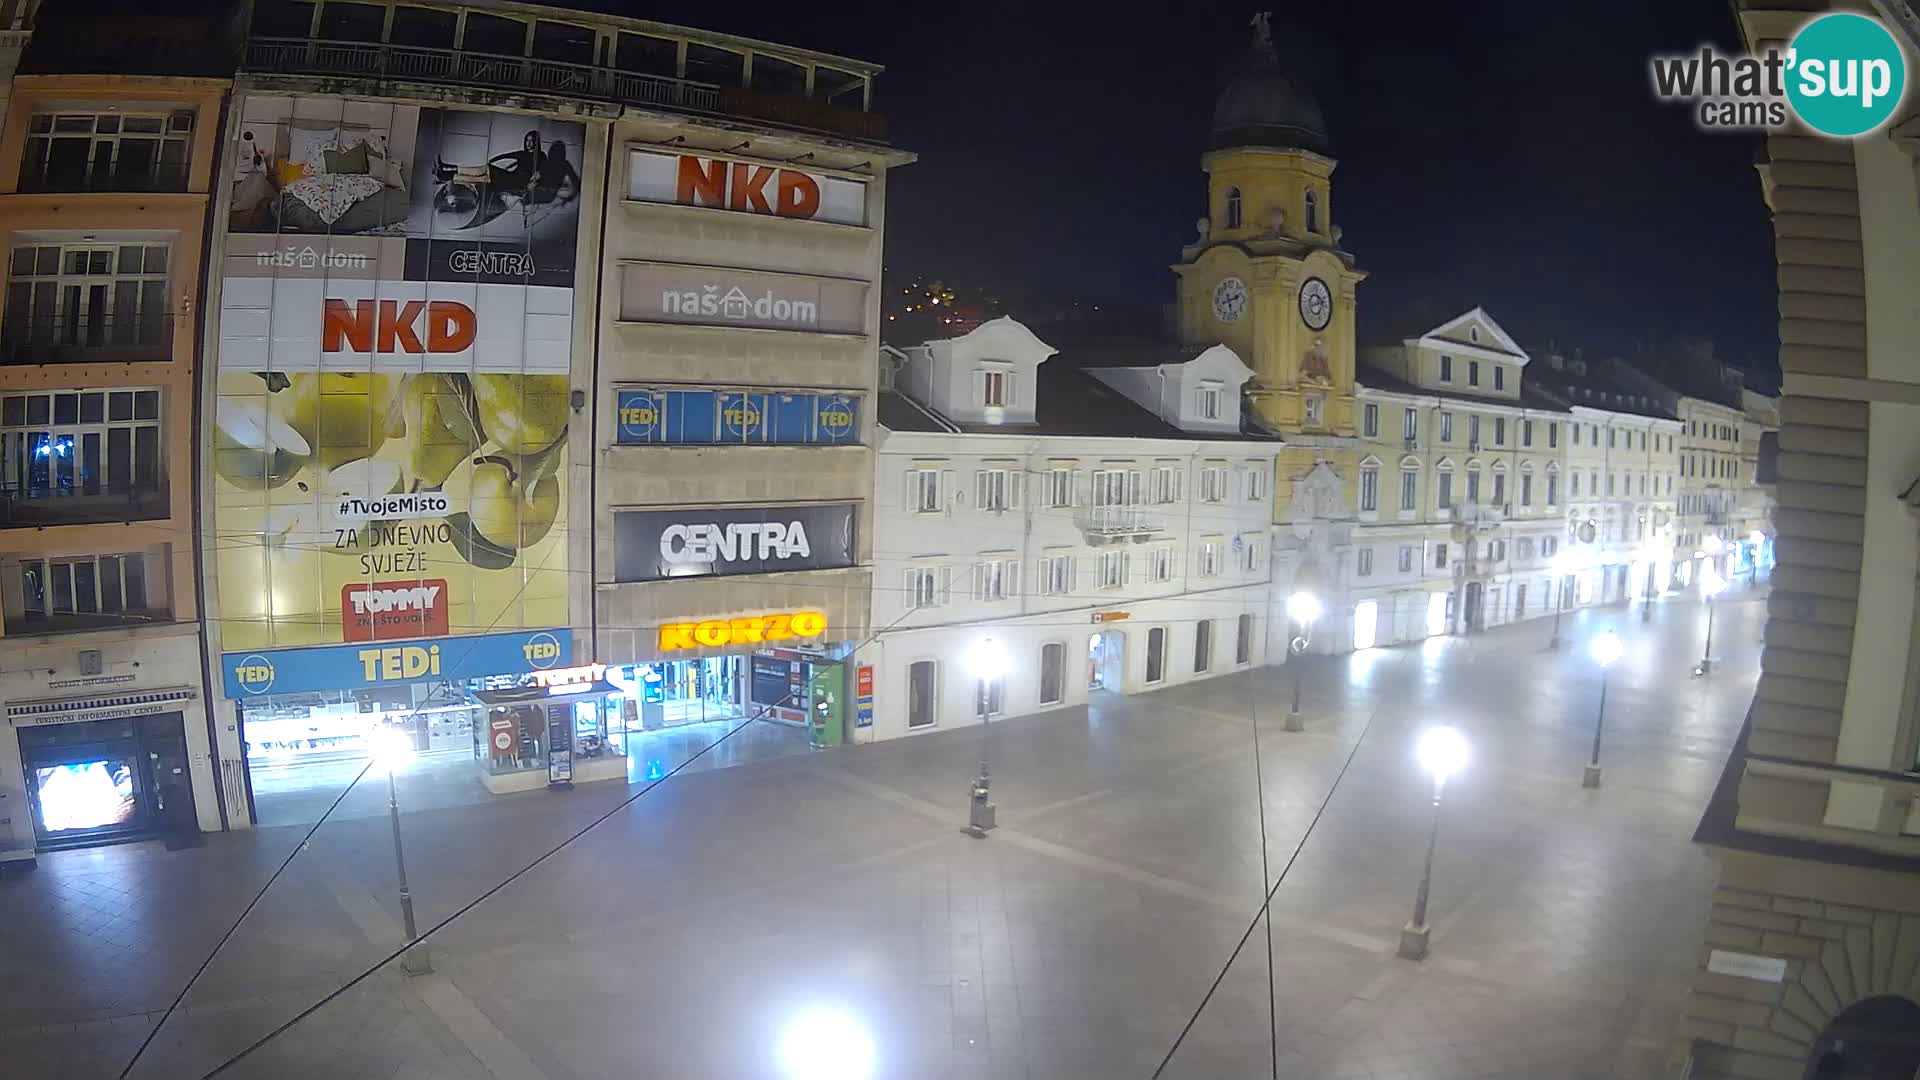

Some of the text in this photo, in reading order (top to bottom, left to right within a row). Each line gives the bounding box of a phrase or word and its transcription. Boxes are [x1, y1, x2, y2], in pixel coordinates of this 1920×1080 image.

[677, 155, 820, 220] NKD
[256, 247, 367, 269] naš dom
[449, 250, 536, 276] CENTRA
[662, 285, 817, 323] naš dom
[322, 298, 478, 354] NKD
[620, 408, 658, 425] TEDi
[724, 409, 760, 425] TEDi
[340, 496, 447, 516] #TvojeMisto
[335, 523, 451, 549] ZA DNEVNO
[660, 520, 811, 563] CENTRA
[361, 548, 428, 575] SVJEŽE
[350, 586, 440, 614] TOMMY
[659, 611, 827, 651] KORZO
[358, 644, 441, 682] TEDi
[523, 642, 561, 660] TEDi
[235, 665, 275, 684] TEDi
[534, 663, 607, 687] TOMMY
